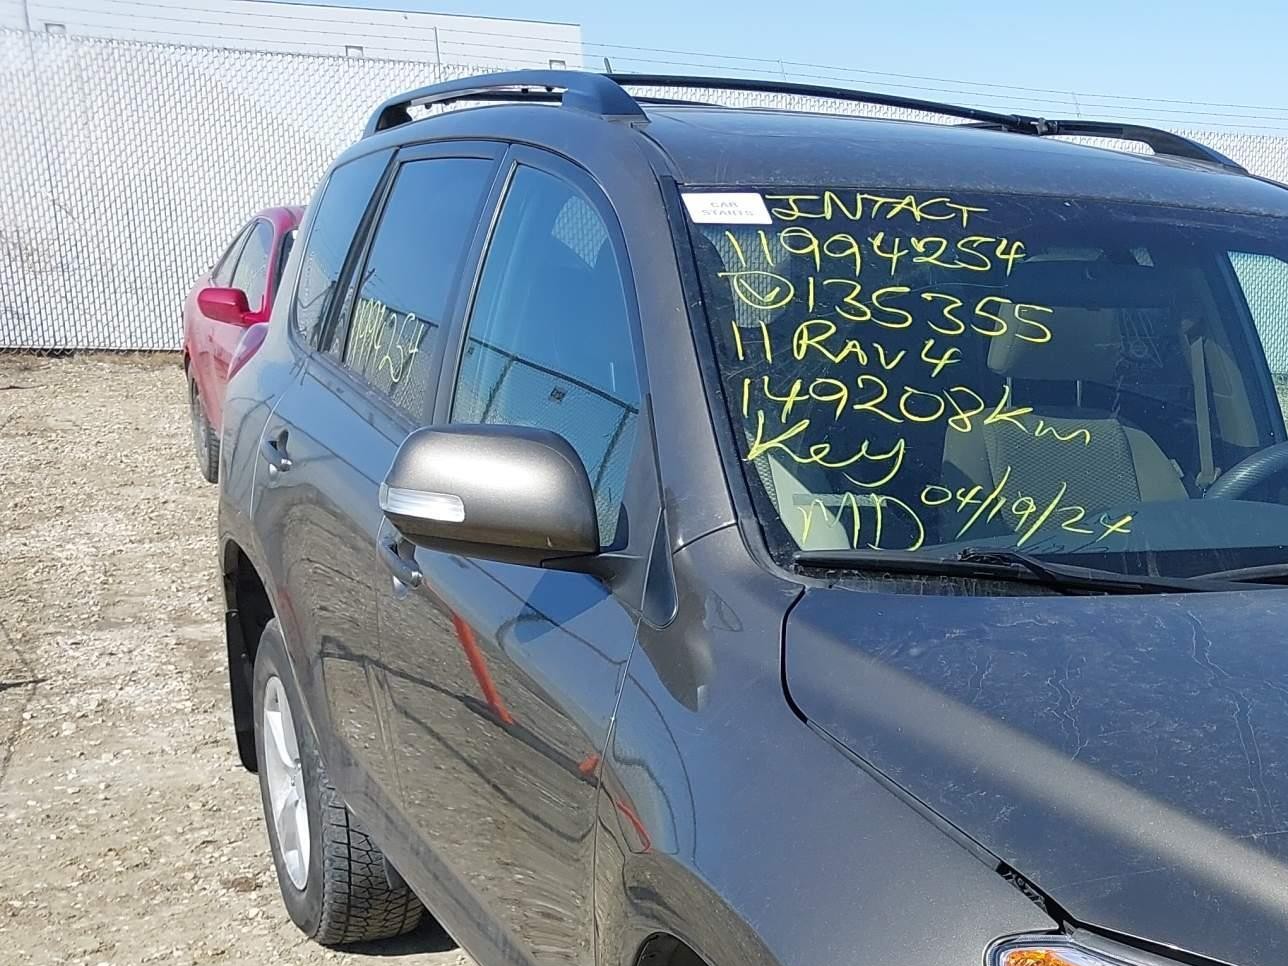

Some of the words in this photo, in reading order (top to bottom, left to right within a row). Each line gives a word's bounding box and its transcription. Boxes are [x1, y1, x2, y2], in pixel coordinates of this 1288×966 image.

[766, 191, 988, 227] INTACT
[724, 228, 1026, 277] 11994254
[742, 410, 907, 487] Key
[920, 465, 1133, 547] 04/19/24
